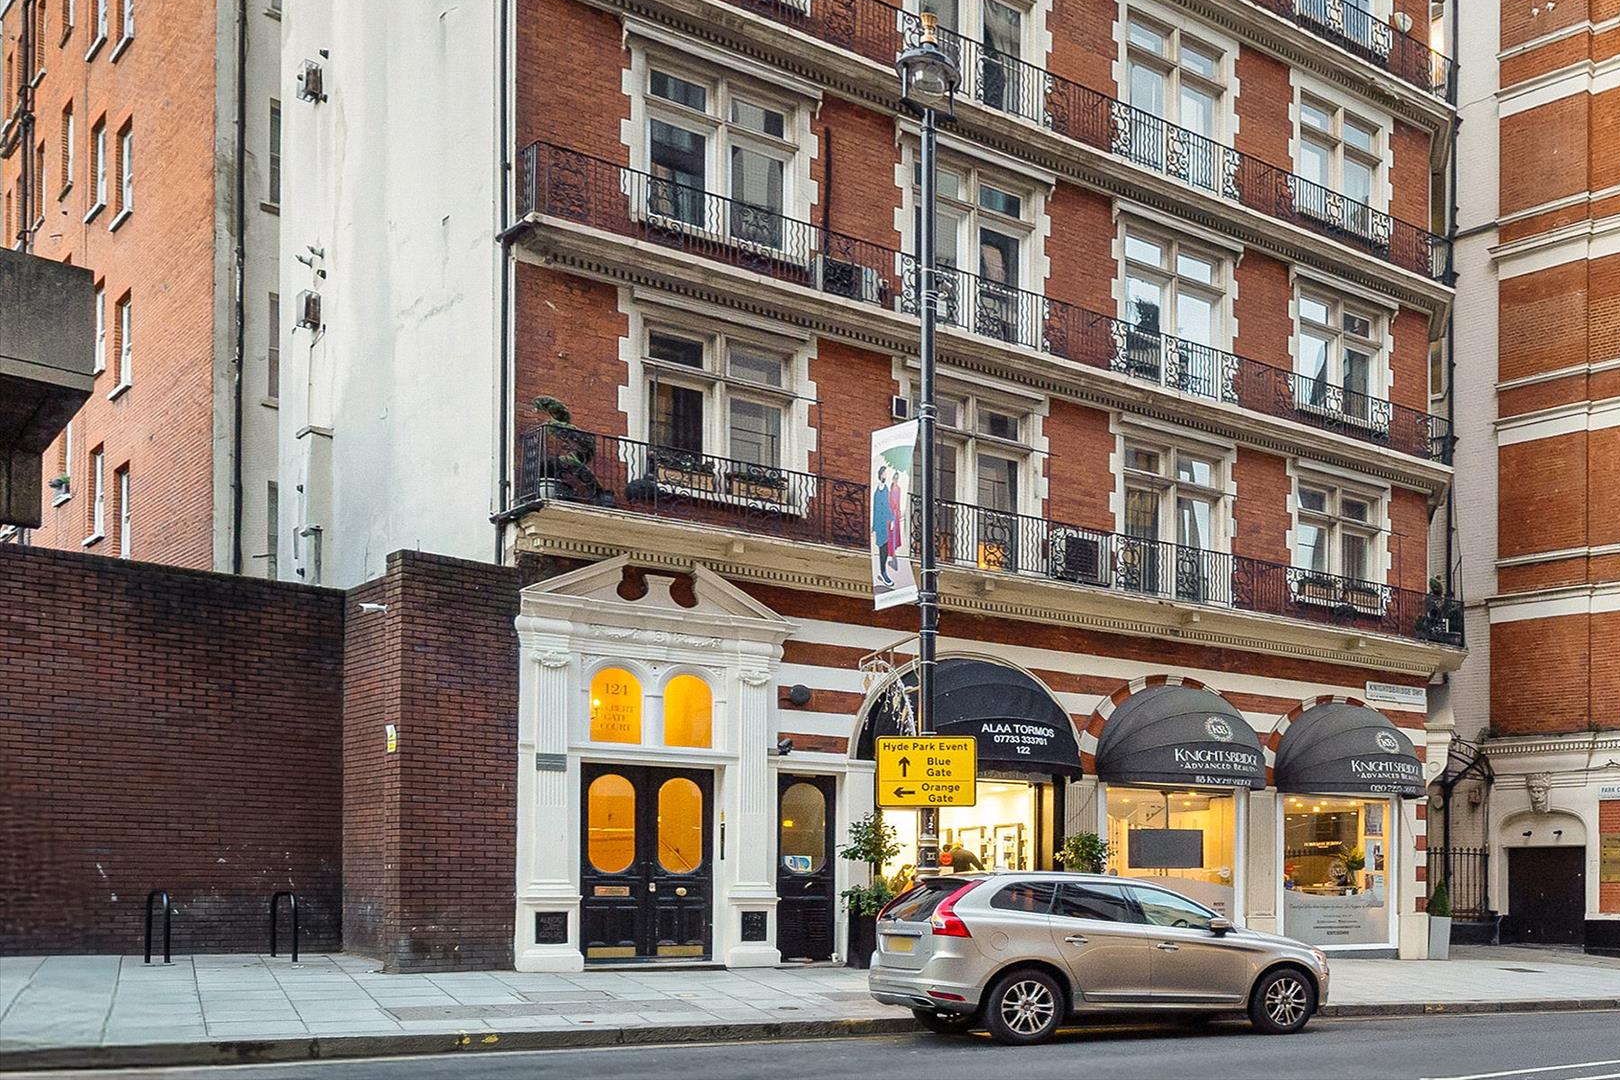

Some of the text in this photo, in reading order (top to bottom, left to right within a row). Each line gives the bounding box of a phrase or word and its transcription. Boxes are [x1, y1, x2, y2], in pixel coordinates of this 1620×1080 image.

[606, 683, 627, 695] 124
[981, 723, 1055, 738] ALAA TORMOS
[993, 735, 1048, 745] 07733 333701
[883, 742, 968, 752] Hyde Park Event
[1016, 746, 1031, 754] 122
[927, 757, 951, 766] Blue
[926, 768, 951, 777] Gate
[921, 783, 960, 793] Orange
[928, 794, 953, 803] Gate
